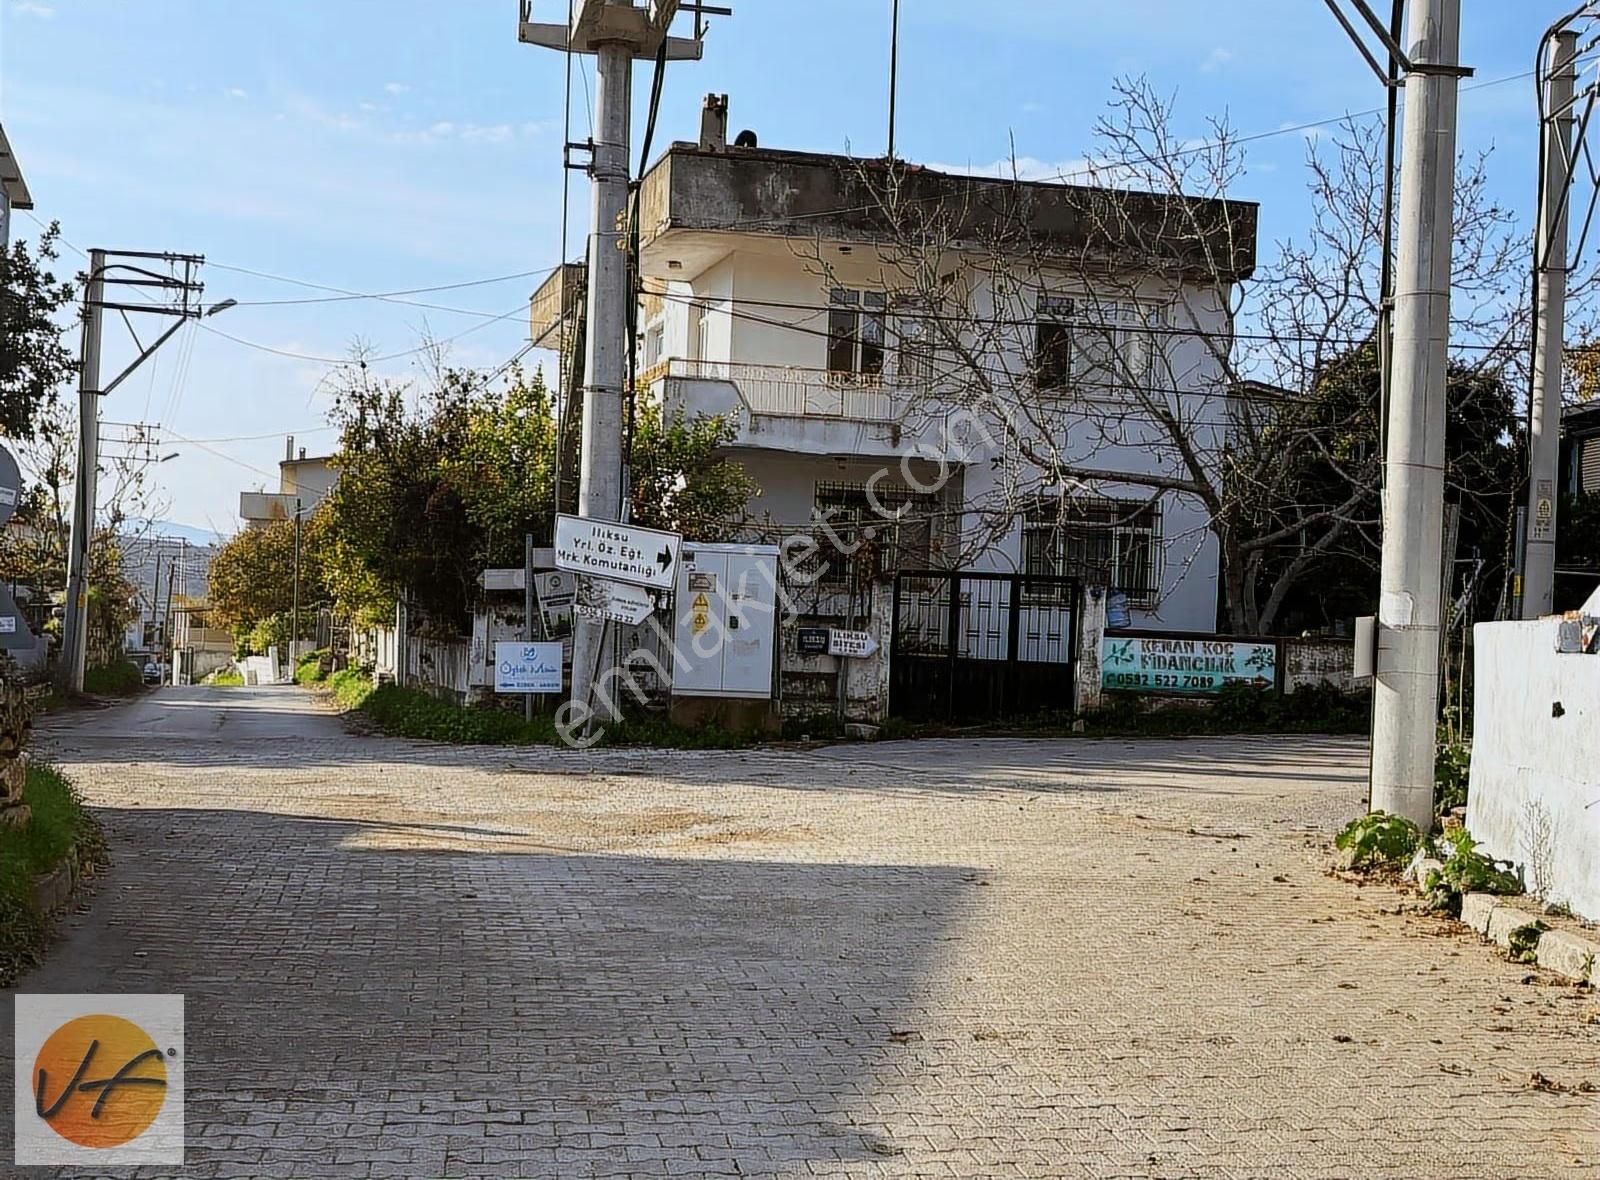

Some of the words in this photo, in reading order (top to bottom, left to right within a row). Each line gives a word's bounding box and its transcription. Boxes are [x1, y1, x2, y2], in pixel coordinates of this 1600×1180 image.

[573, 537, 594, 551] Yrl.
[620, 546, 644, 560] Eğt.
[583, 554, 656, 577] Komutanlığı
[1202, 642, 1234, 656] KOÇ
[1154, 674, 1178, 687] 522
[1183, 675, 1214, 688] 7089
